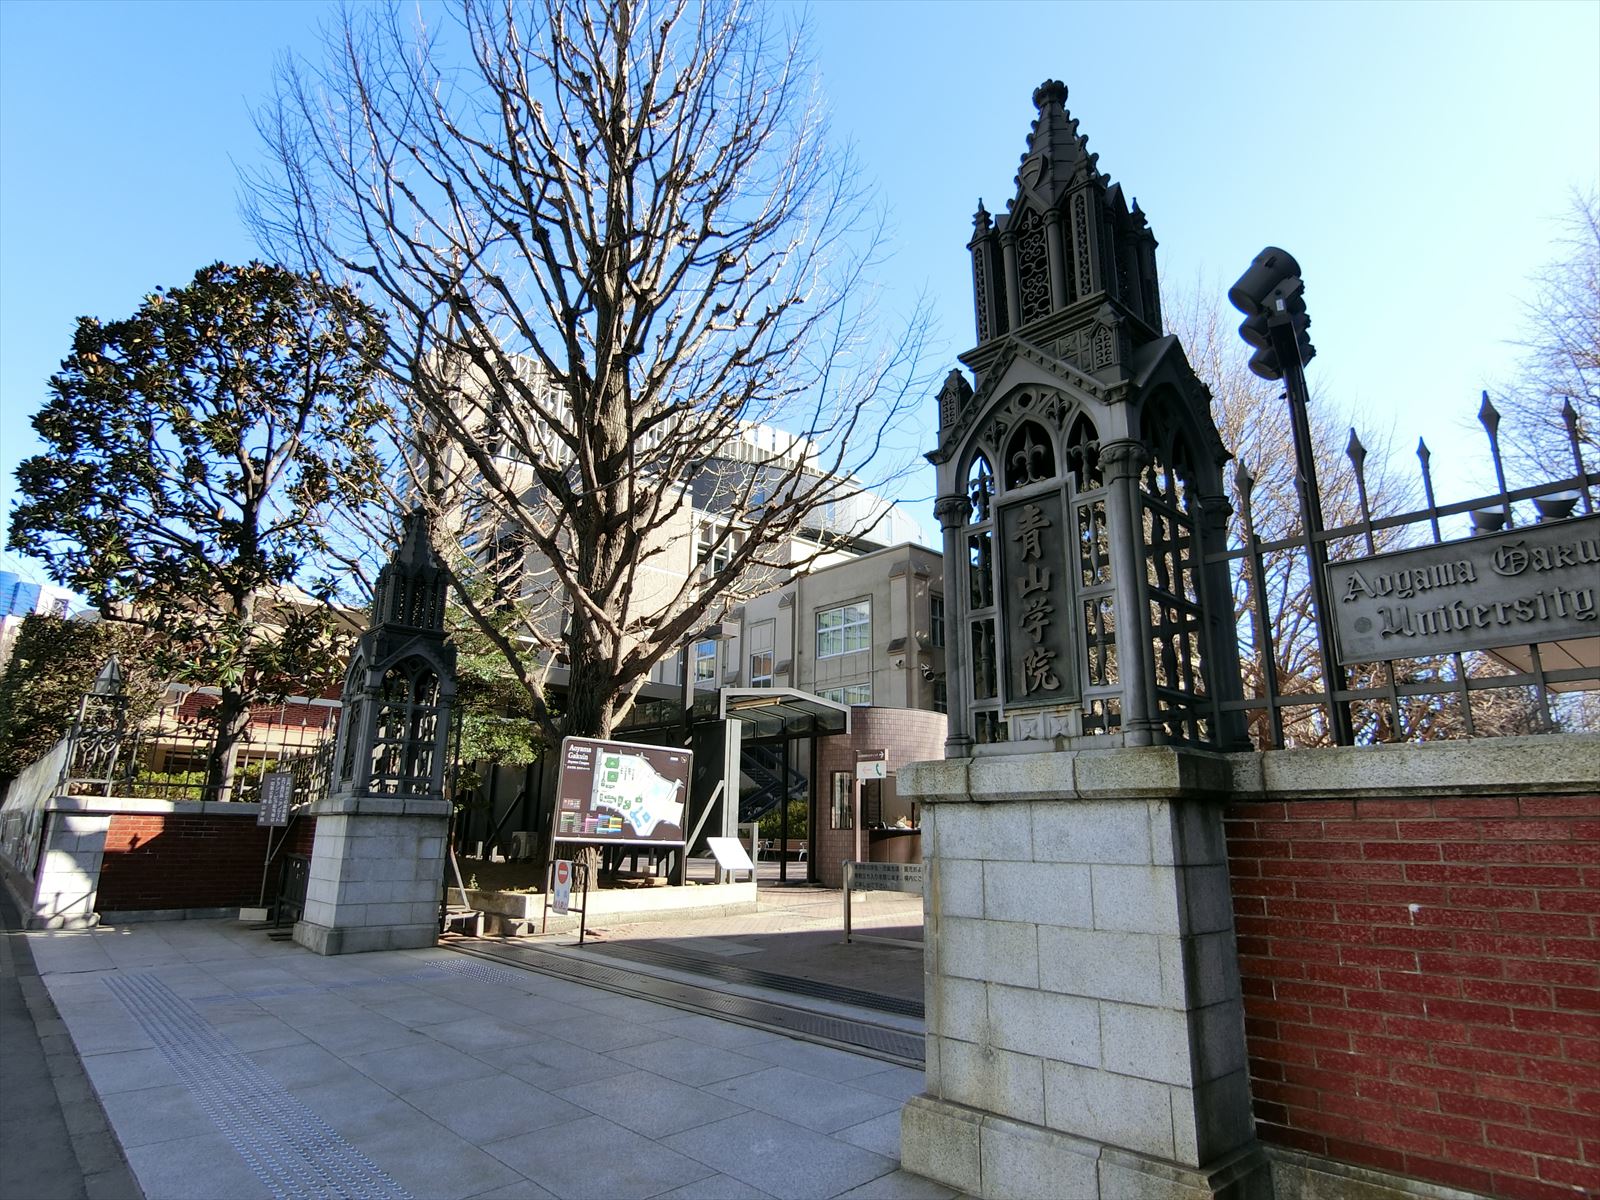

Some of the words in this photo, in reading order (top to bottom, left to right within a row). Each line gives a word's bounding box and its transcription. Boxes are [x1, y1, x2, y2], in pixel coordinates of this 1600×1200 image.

[1344, 559, 1477, 603] Aoyama
[1490, 539, 1600, 577] Gaku
[1012, 504, 1061, 697] 青山学院
[1378, 586, 1598, 639] University
[568, 752, 589, 760] Gakuin
[569, 744, 592, 754] Aoyama
